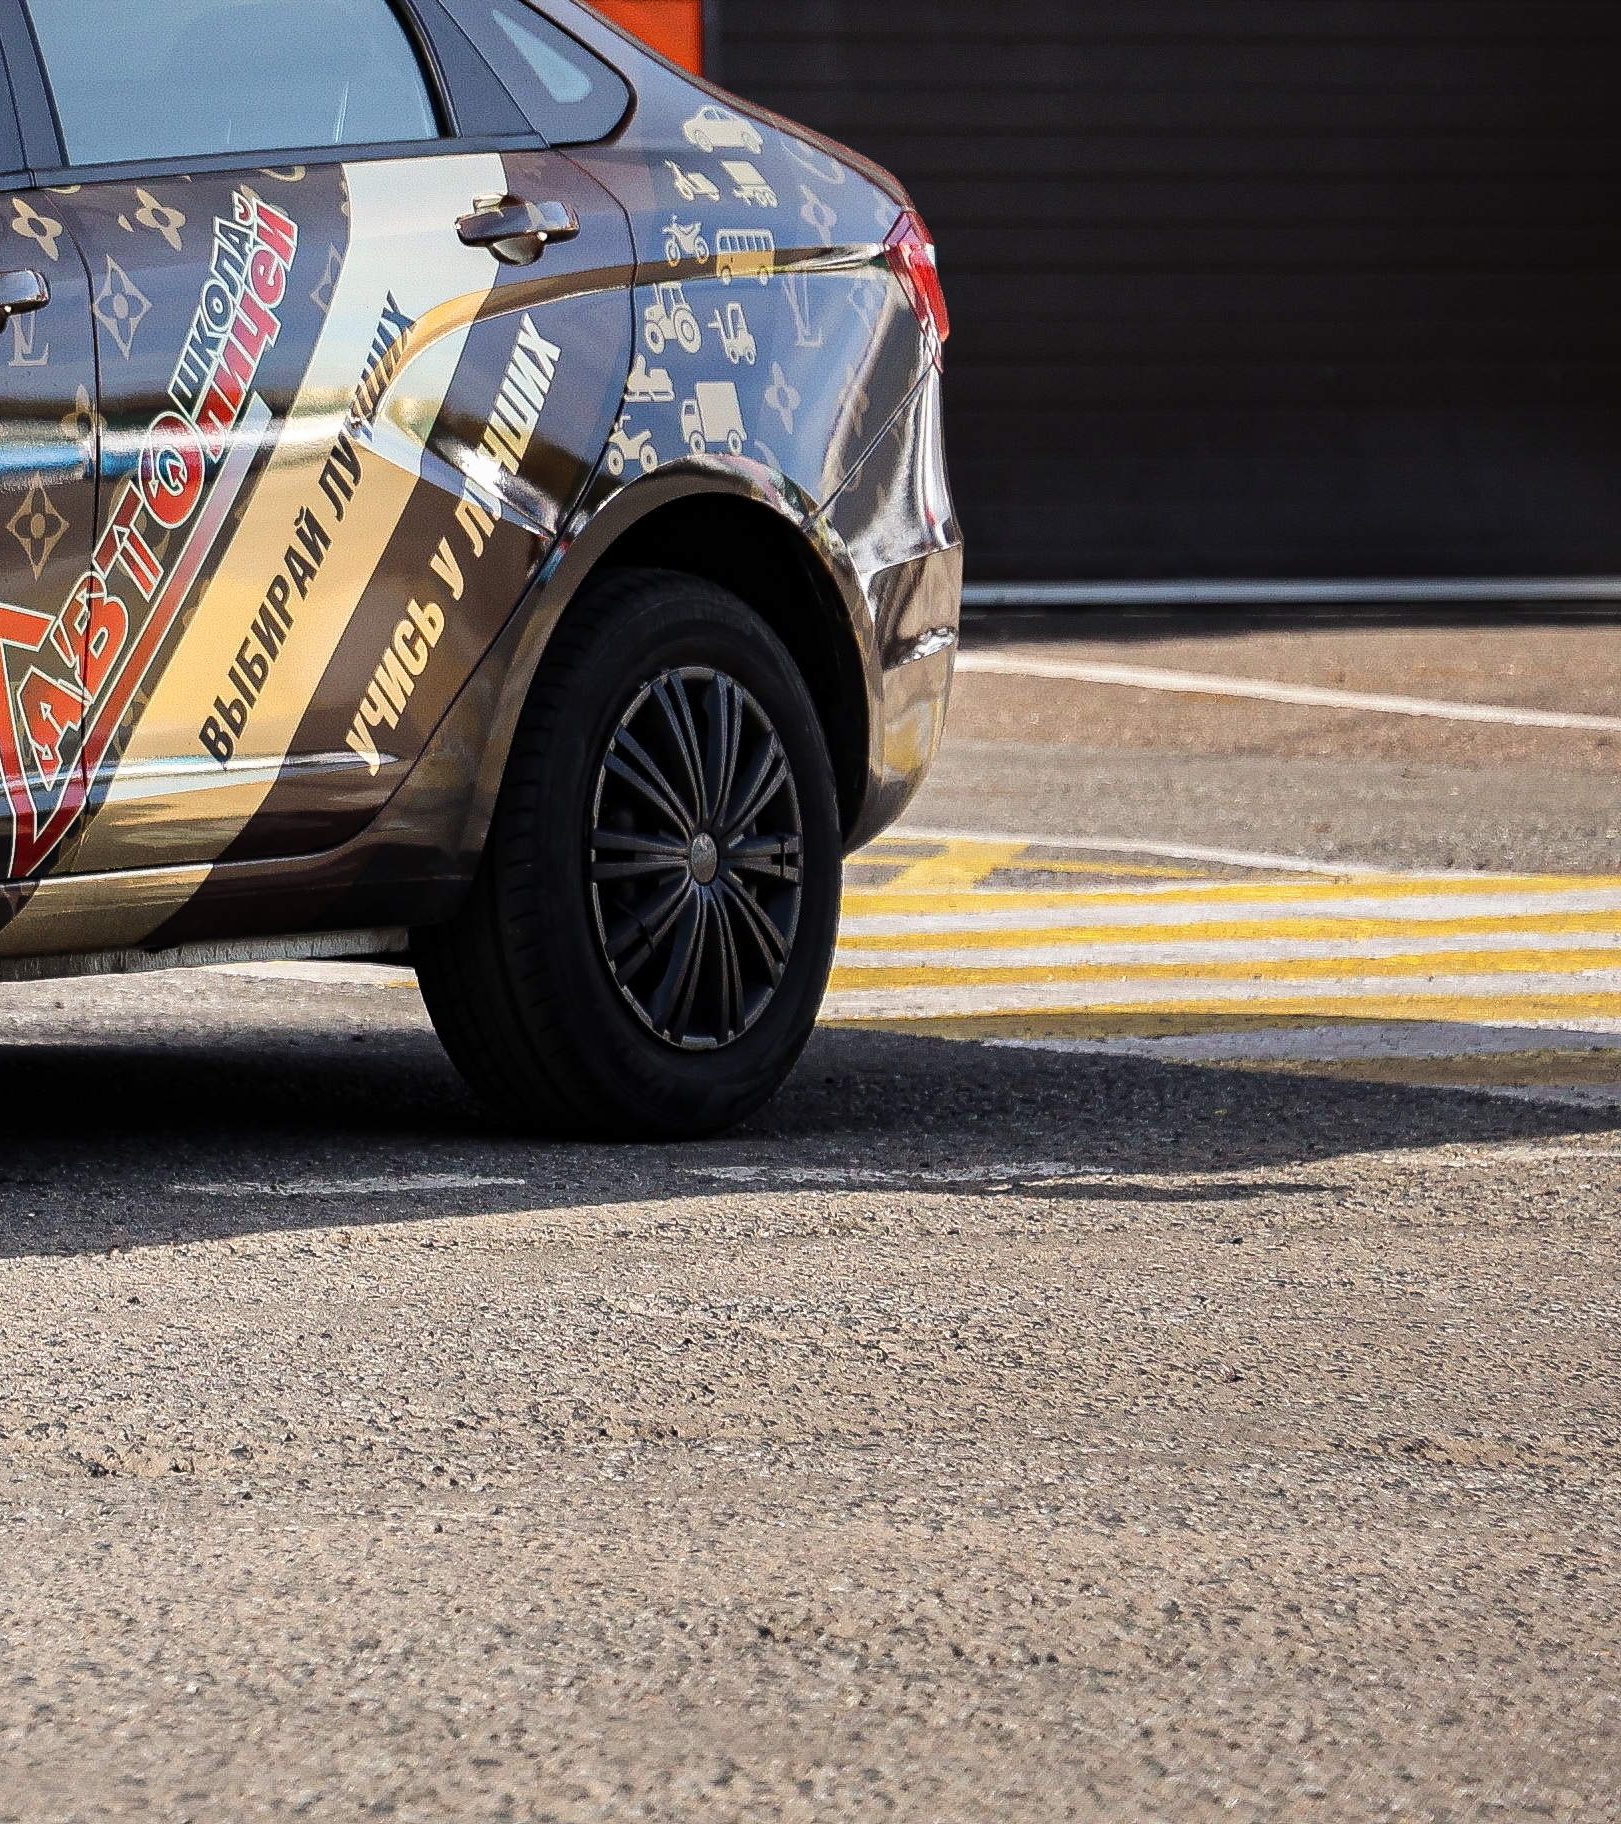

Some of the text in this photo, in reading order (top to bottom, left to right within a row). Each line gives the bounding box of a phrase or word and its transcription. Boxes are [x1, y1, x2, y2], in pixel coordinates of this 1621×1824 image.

[189, 195, 298, 457] лицей
[17, 212, 255, 790] АВТО ШКОЛА
[198, 506, 333, 771] ВЫБИРАЙ
[345, 598, 445, 777] УЧИСЬ
[429, 536, 465, 601] У
